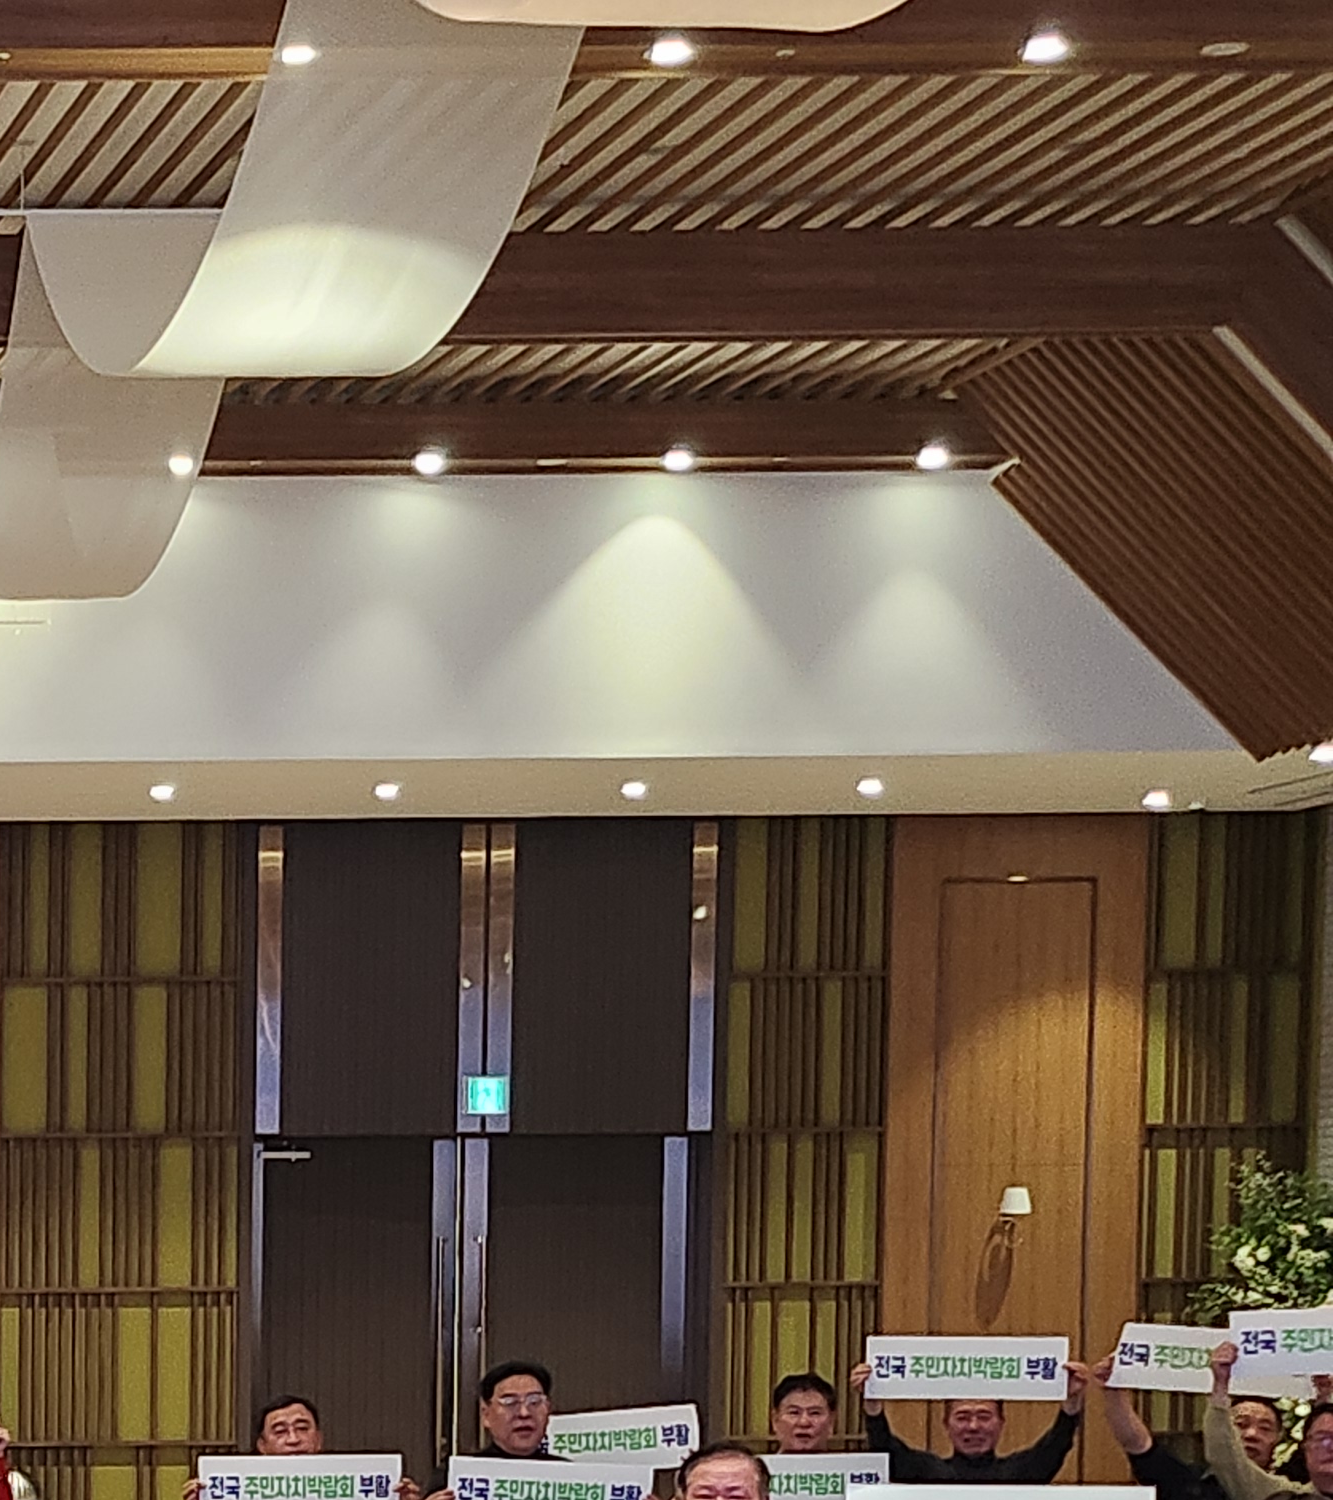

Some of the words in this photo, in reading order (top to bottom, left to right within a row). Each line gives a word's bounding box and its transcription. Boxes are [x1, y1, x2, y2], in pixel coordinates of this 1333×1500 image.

[1118, 1343, 1149, 1367] 전국
[1241, 1330, 1278, 1355] 전국
[874, 1356, 906, 1380] 전국
[909, 1355, 1021, 1380] 주민자치박람회
[1025, 1356, 1058, 1380] 부활
[553, 1426, 657, 1454] 주민자치박람회
[661, 1424, 690, 1448] 부활
[208, 1476, 241, 1500] 전국
[243, 1474, 354, 1499] 주민자치박람회
[359, 1475, 390, 1499] 부활
[769, 1471, 845, 1496] 자치박람회
